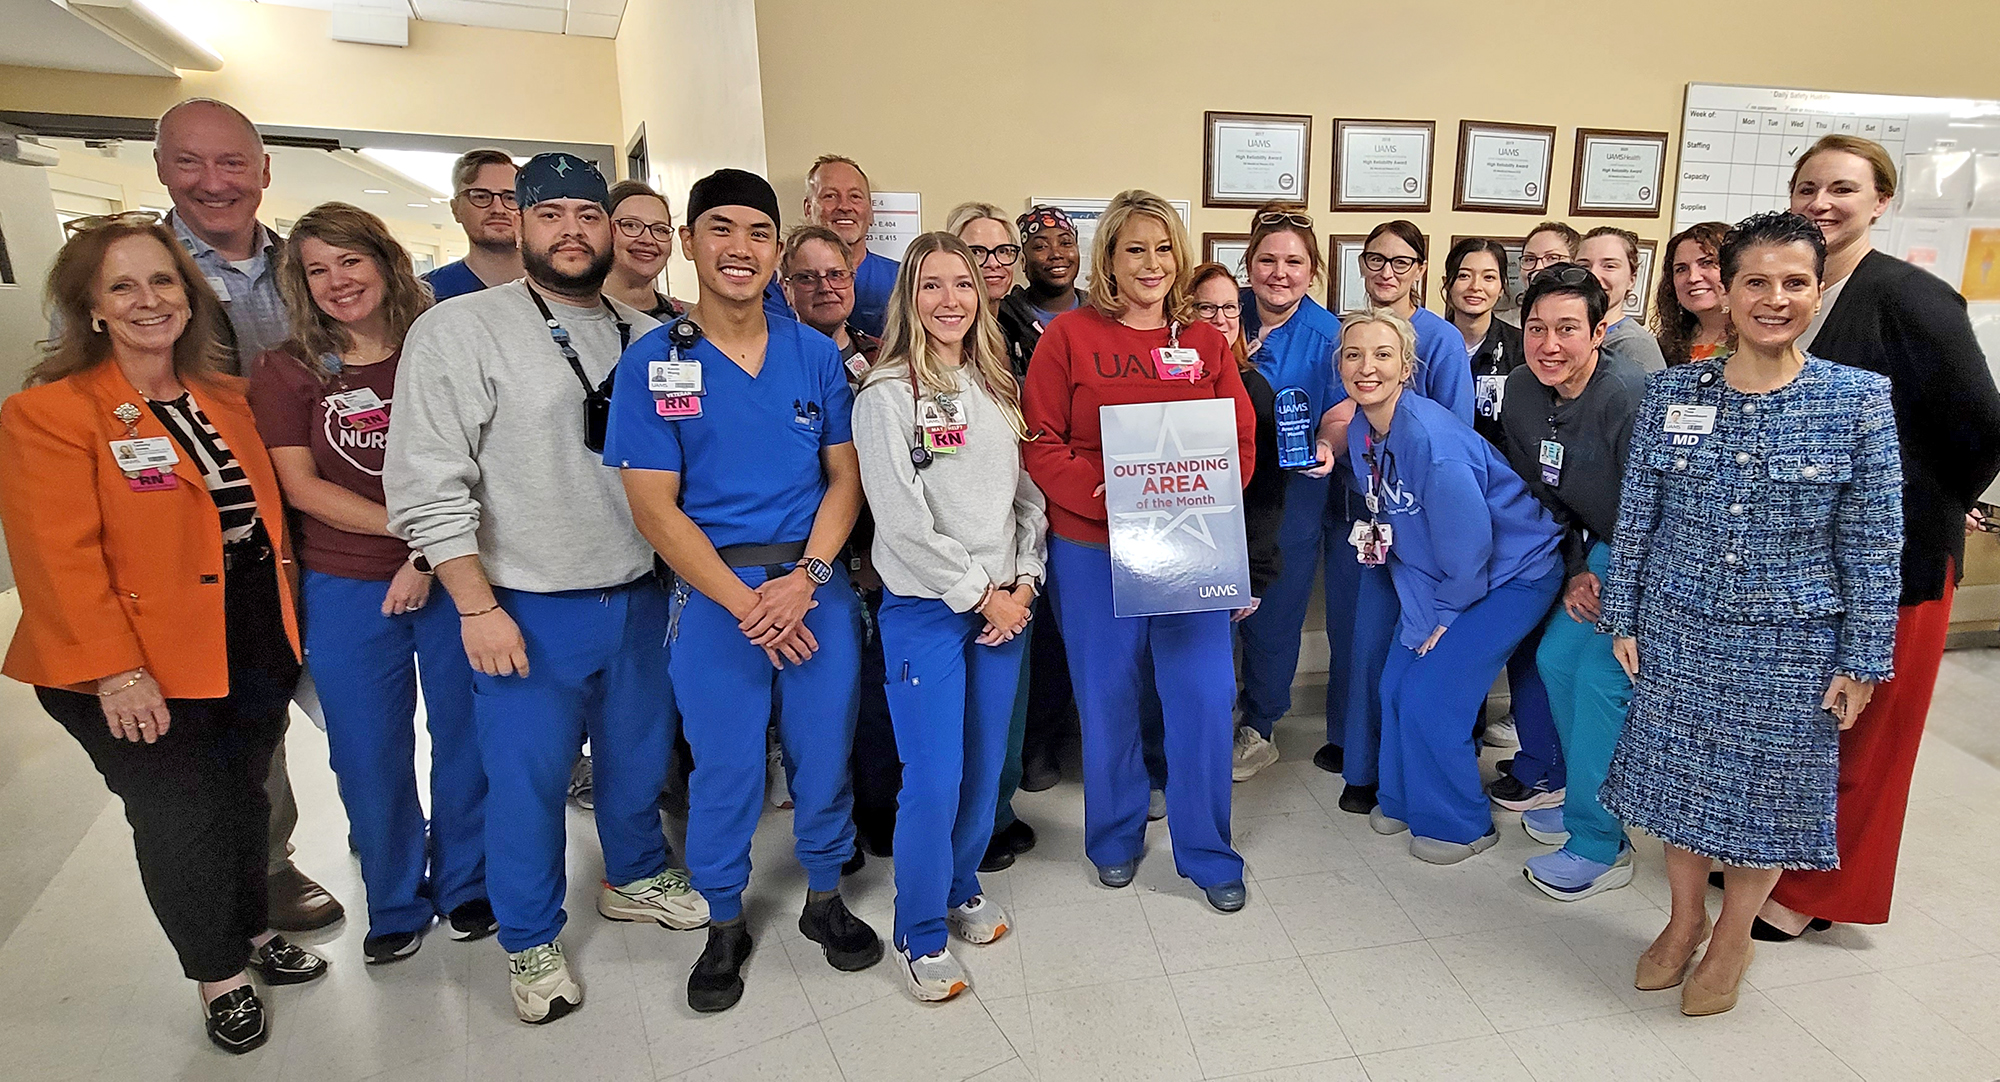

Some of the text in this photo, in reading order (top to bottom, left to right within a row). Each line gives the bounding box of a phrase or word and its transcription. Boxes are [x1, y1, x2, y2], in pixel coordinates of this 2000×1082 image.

[1773, 90, 1788, 99] Daily
[1690, 110, 1706, 118] Week
[1790, 120, 1804, 128] Wed
[1247, 139, 1271, 148] UAMS
[1686, 141, 1710, 151] Staffing
[1374, 145, 1397, 153] UAMS
[1498, 148, 1519, 156] UAMS
[1683, 173, 1710, 181] Capacity
[1680, 203, 1707, 211] Supplies
[664, 398, 690, 409] RN
[1278, 402, 1308, 414] UAMS
[358, 414, 383, 425] RN
[934, 433, 962, 446] RN
[1672, 434, 1699, 446] MD
[1113, 457, 1229, 478] OUTSTANDING
[140, 474, 164, 486] RN
[1142, 474, 1209, 496] AREA
[1136, 494, 1215, 510] of the Month
